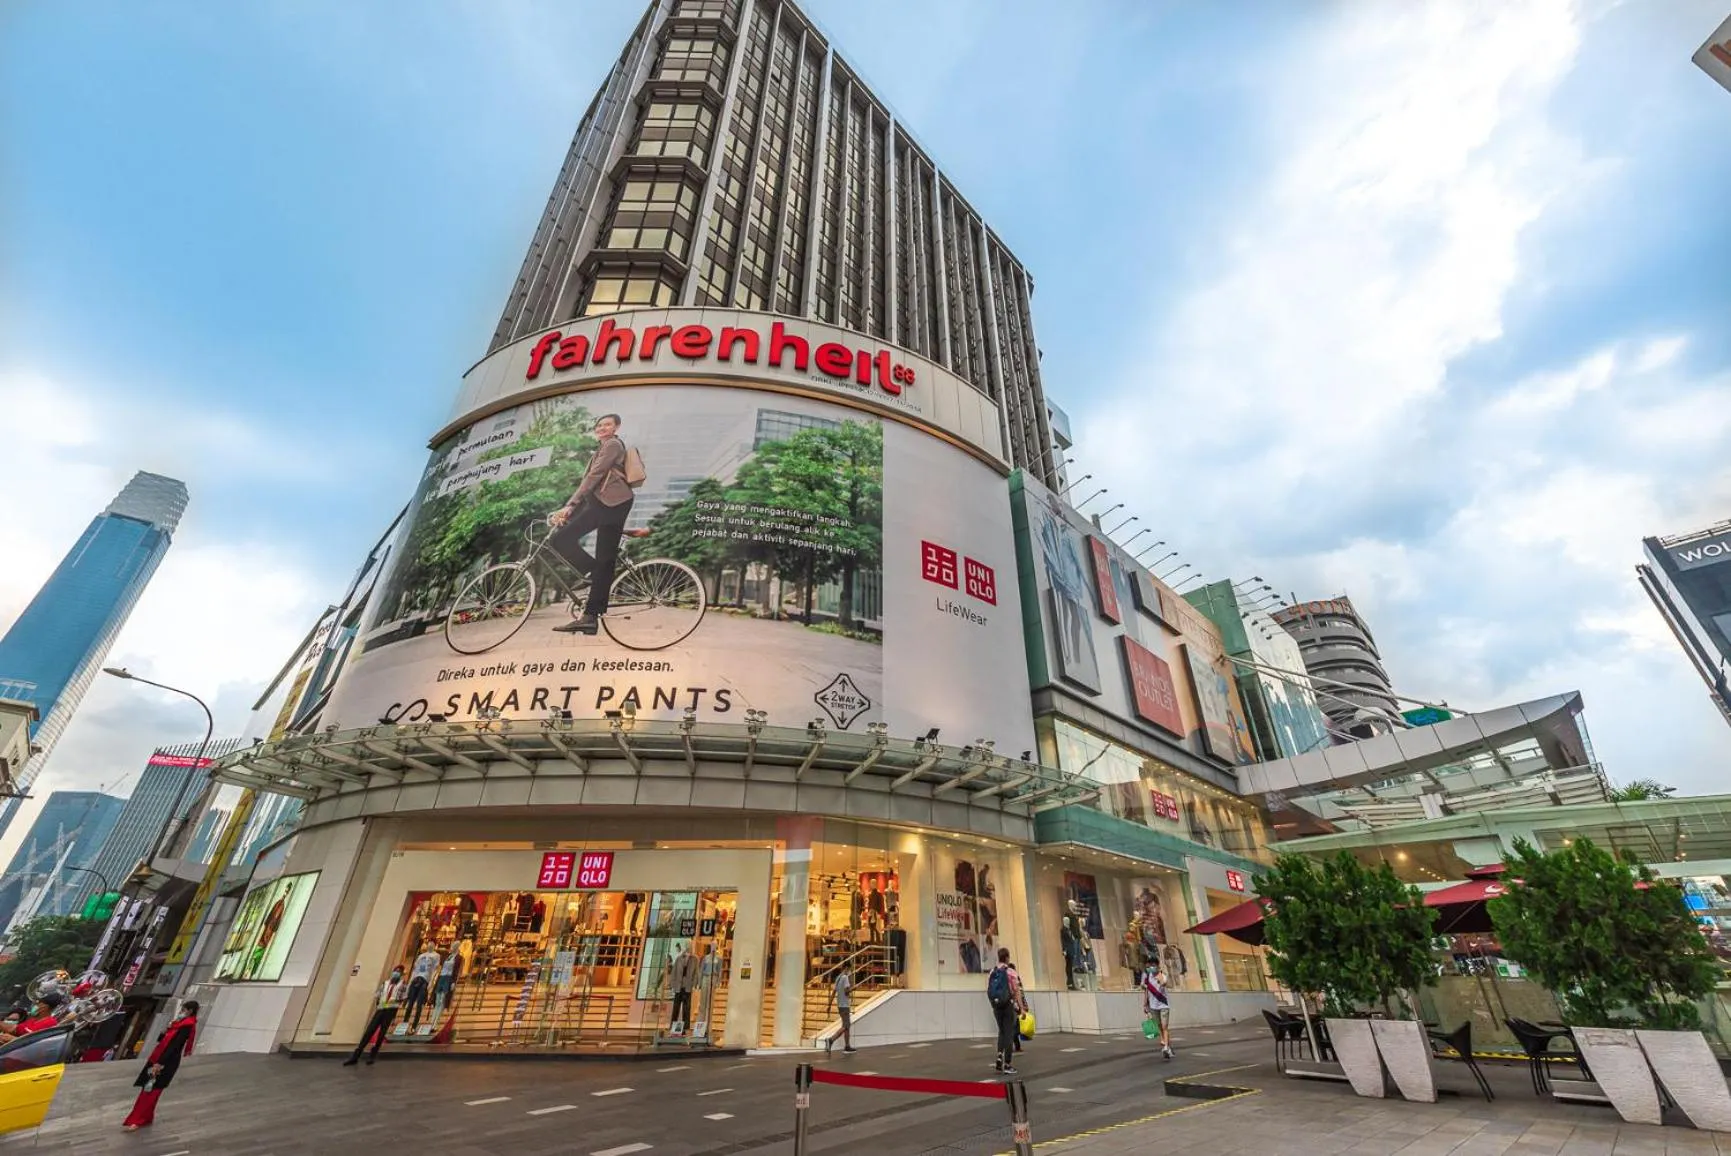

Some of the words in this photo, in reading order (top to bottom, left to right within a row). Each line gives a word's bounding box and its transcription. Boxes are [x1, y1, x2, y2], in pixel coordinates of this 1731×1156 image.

[526, 319, 902, 395] fahrenheit
[696, 500, 720, 510] Gaya
[724, 503, 747, 512] yang
[750, 506, 813, 520] mengaktifkan
[695, 513, 725, 523] Sesuai
[728, 517, 756, 526] untuk
[760, 520, 801, 534] berulang
[824, 529, 835, 537] ke
[692, 528, 728, 538] pejabat
[731, 530, 749, 540] dan
[752, 533, 785, 544] aktiviti
[788, 538, 833, 553] sepanjang
[968, 562, 991, 584] UNI
[969, 578, 994, 599] QLO
[936, 597, 988, 626] LifeWear
[437, 667, 475, 683] Direka
[480, 661, 517, 677] untuk
[522, 662, 555, 677] gaya
[560, 658, 586, 672] dan
[592, 658, 675, 673] keselesaan.
[444, 686, 580, 718] SMART
[595, 686, 732, 713] PANTS
[583, 856, 608, 869] UNI
[581, 870, 607, 885] QLO
[703, 920, 713, 935] U
